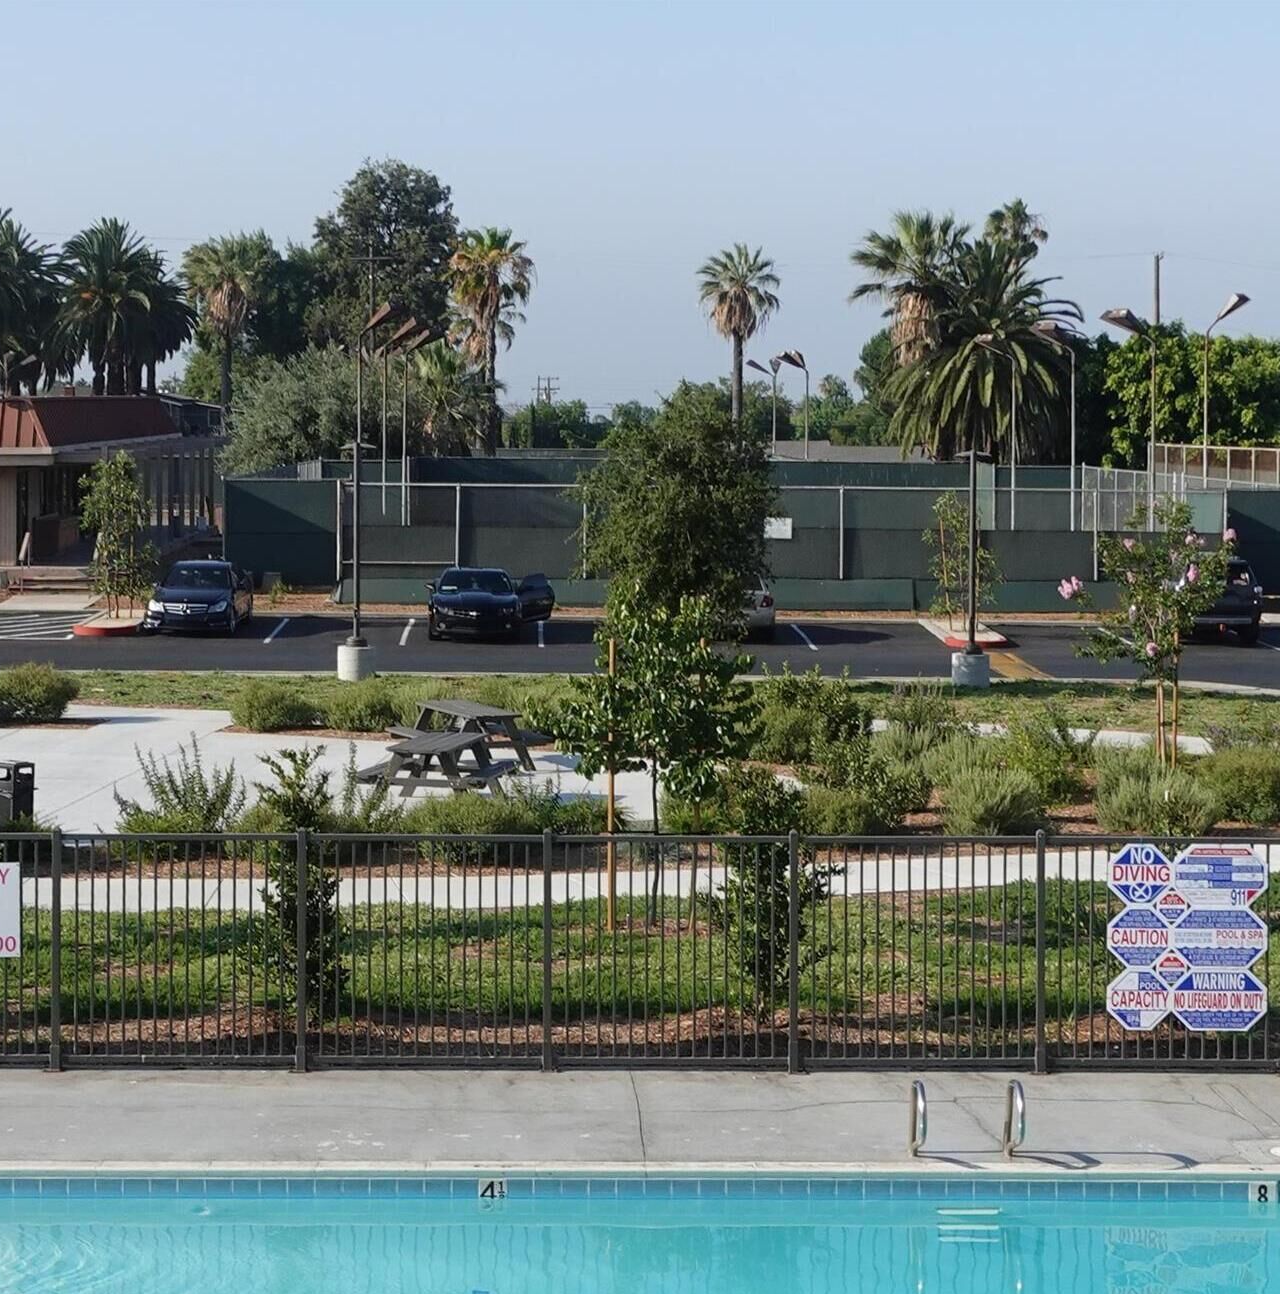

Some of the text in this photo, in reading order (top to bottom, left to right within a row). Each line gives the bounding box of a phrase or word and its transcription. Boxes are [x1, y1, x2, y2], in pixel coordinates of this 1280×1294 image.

[1130, 847, 1155, 864] NO
[1112, 865, 1170, 882] DIVING
[1231, 889, 1246, 906] 911
[1111, 929, 1169, 946] CAUTION
[1216, 930, 1238, 939] POOL
[1248, 930, 1264, 940] SPA
[1139, 982, 1162, 991] POOL
[1192, 973, 1246, 991] WARNING
[1111, 991, 1169, 1008] CAPACITY
[1174, 992, 1264, 1009] NO LIFEGUARD ON DUTY
[1257, 1184, 1268, 1203] 8
